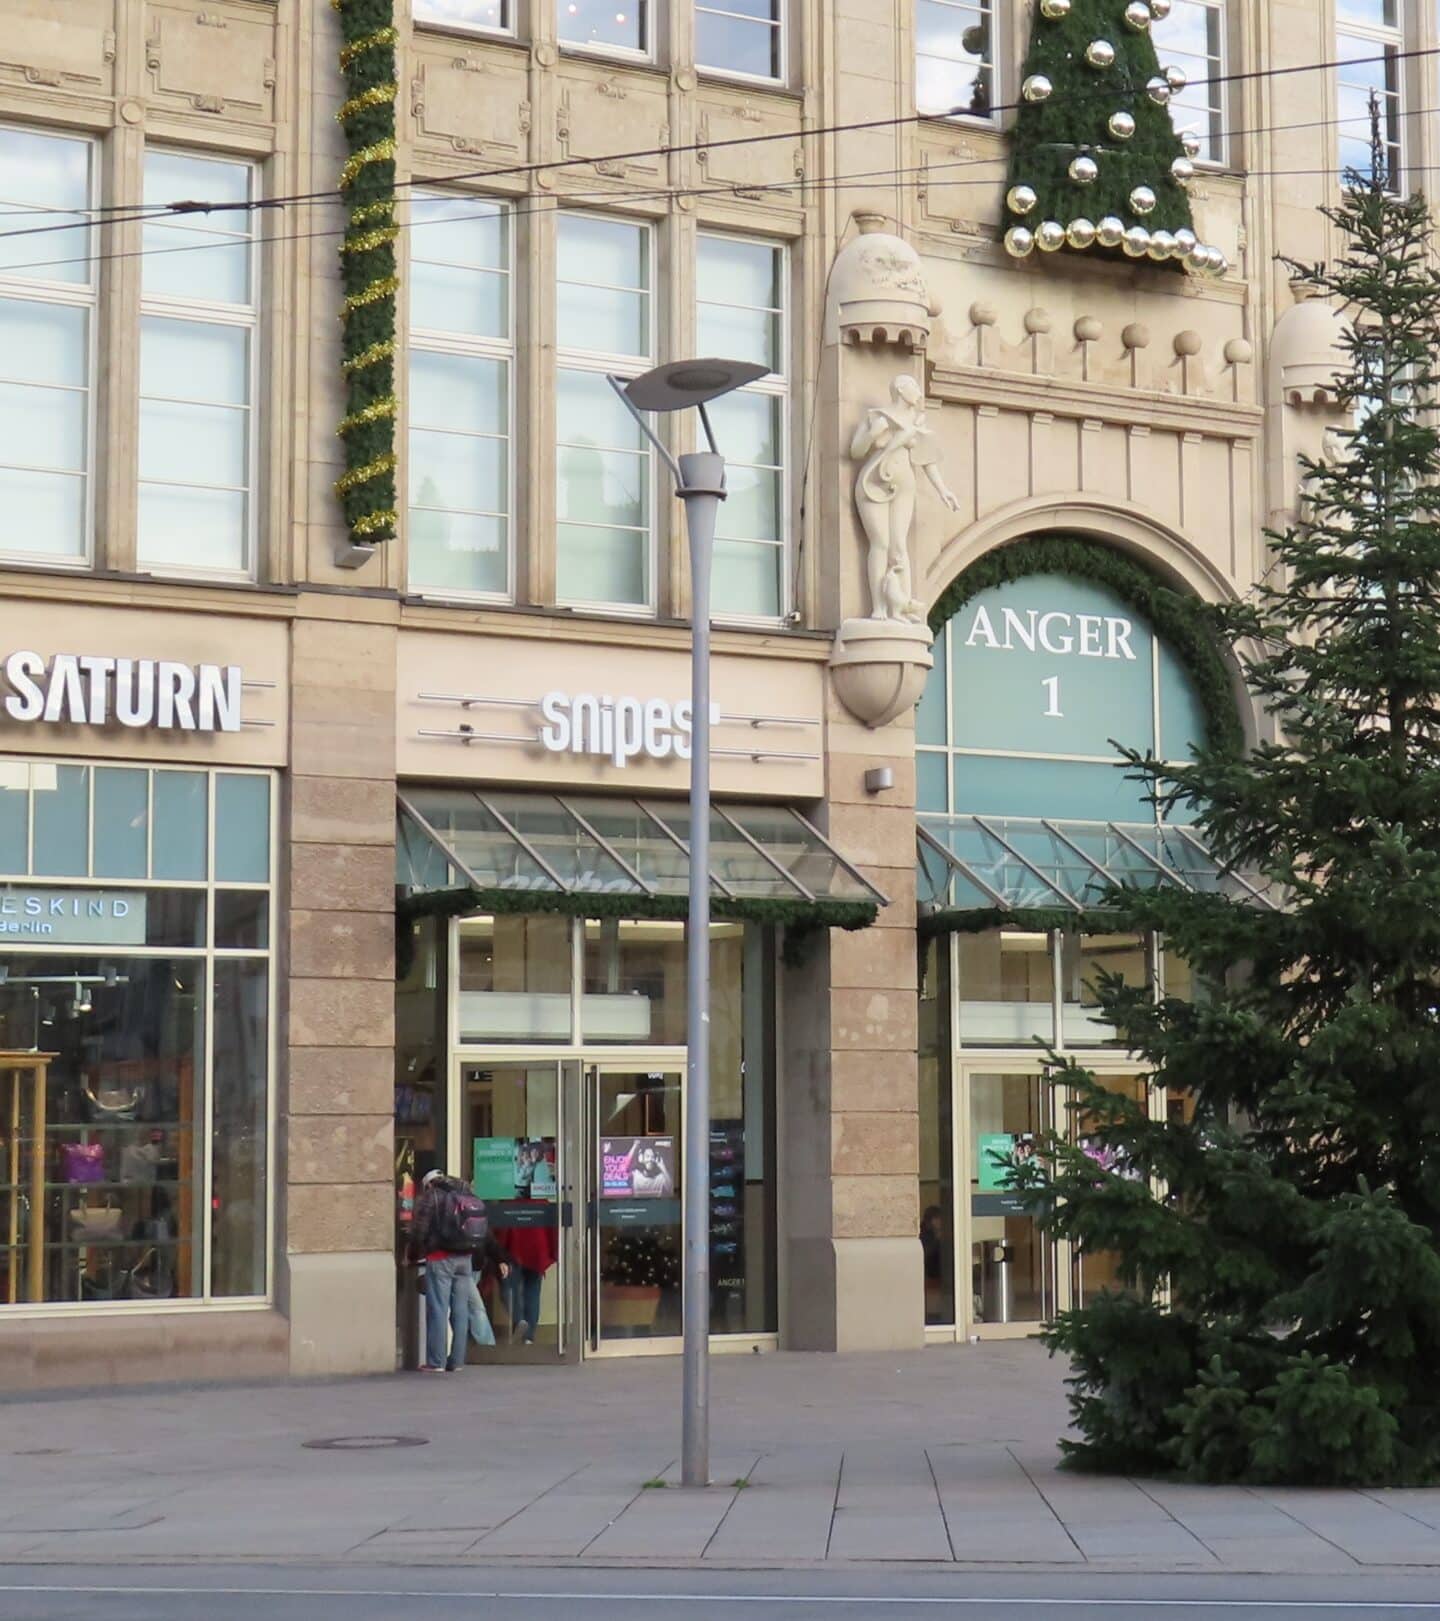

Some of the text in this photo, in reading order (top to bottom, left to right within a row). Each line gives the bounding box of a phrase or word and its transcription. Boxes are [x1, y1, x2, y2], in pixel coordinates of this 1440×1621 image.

[965, 605, 1136, 660] ANGER
[5, 650, 241, 732] SATURN
[1041, 675, 1064, 717] 1
